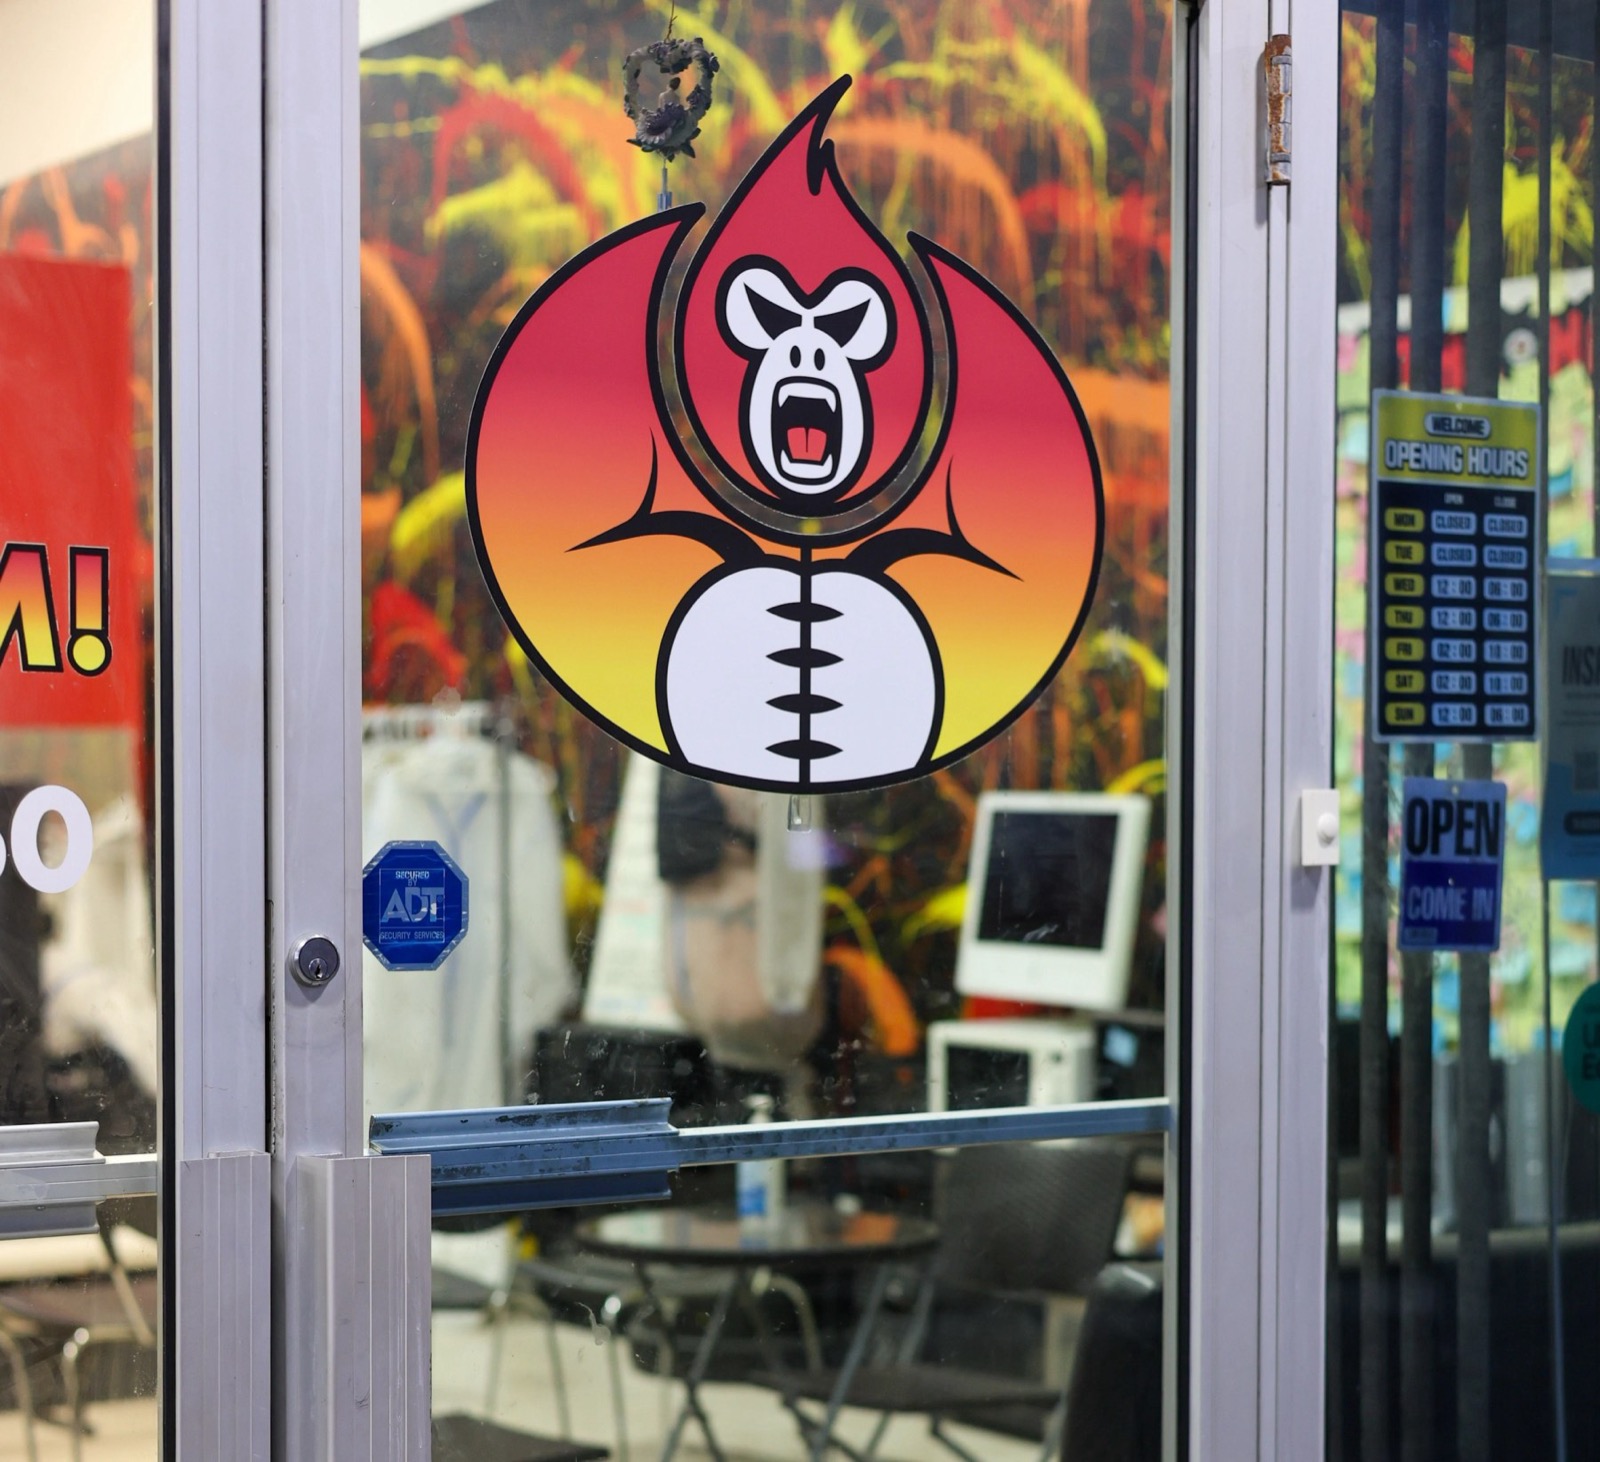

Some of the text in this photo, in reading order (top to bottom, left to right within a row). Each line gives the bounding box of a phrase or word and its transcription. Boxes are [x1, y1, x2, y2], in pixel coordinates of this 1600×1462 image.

[1431, 417, 1485, 436] WELCOME
[1386, 440, 1528, 477] OPENING HOURS
[1394, 513, 1523, 533] MON CLOSED CLOSED
[1395, 545, 1523, 564] TUE CLOSED CLOSED
[1394, 578, 1415, 592] WED
[1395, 610, 1413, 624] THU
[1396, 643, 1412, 656] FRI
[1562, 646, 1600, 686] INS
[1395, 675, 1414, 688] SAT
[1395, 707, 1414, 721] SUN
[1405, 797, 1500, 857] OPEN
[395, 871, 430, 880] SECURED
[380, 887, 445, 923] ADT
[1408, 886, 1494, 921] COME IN
[380, 931, 444, 939] SECURITY SERVICES
